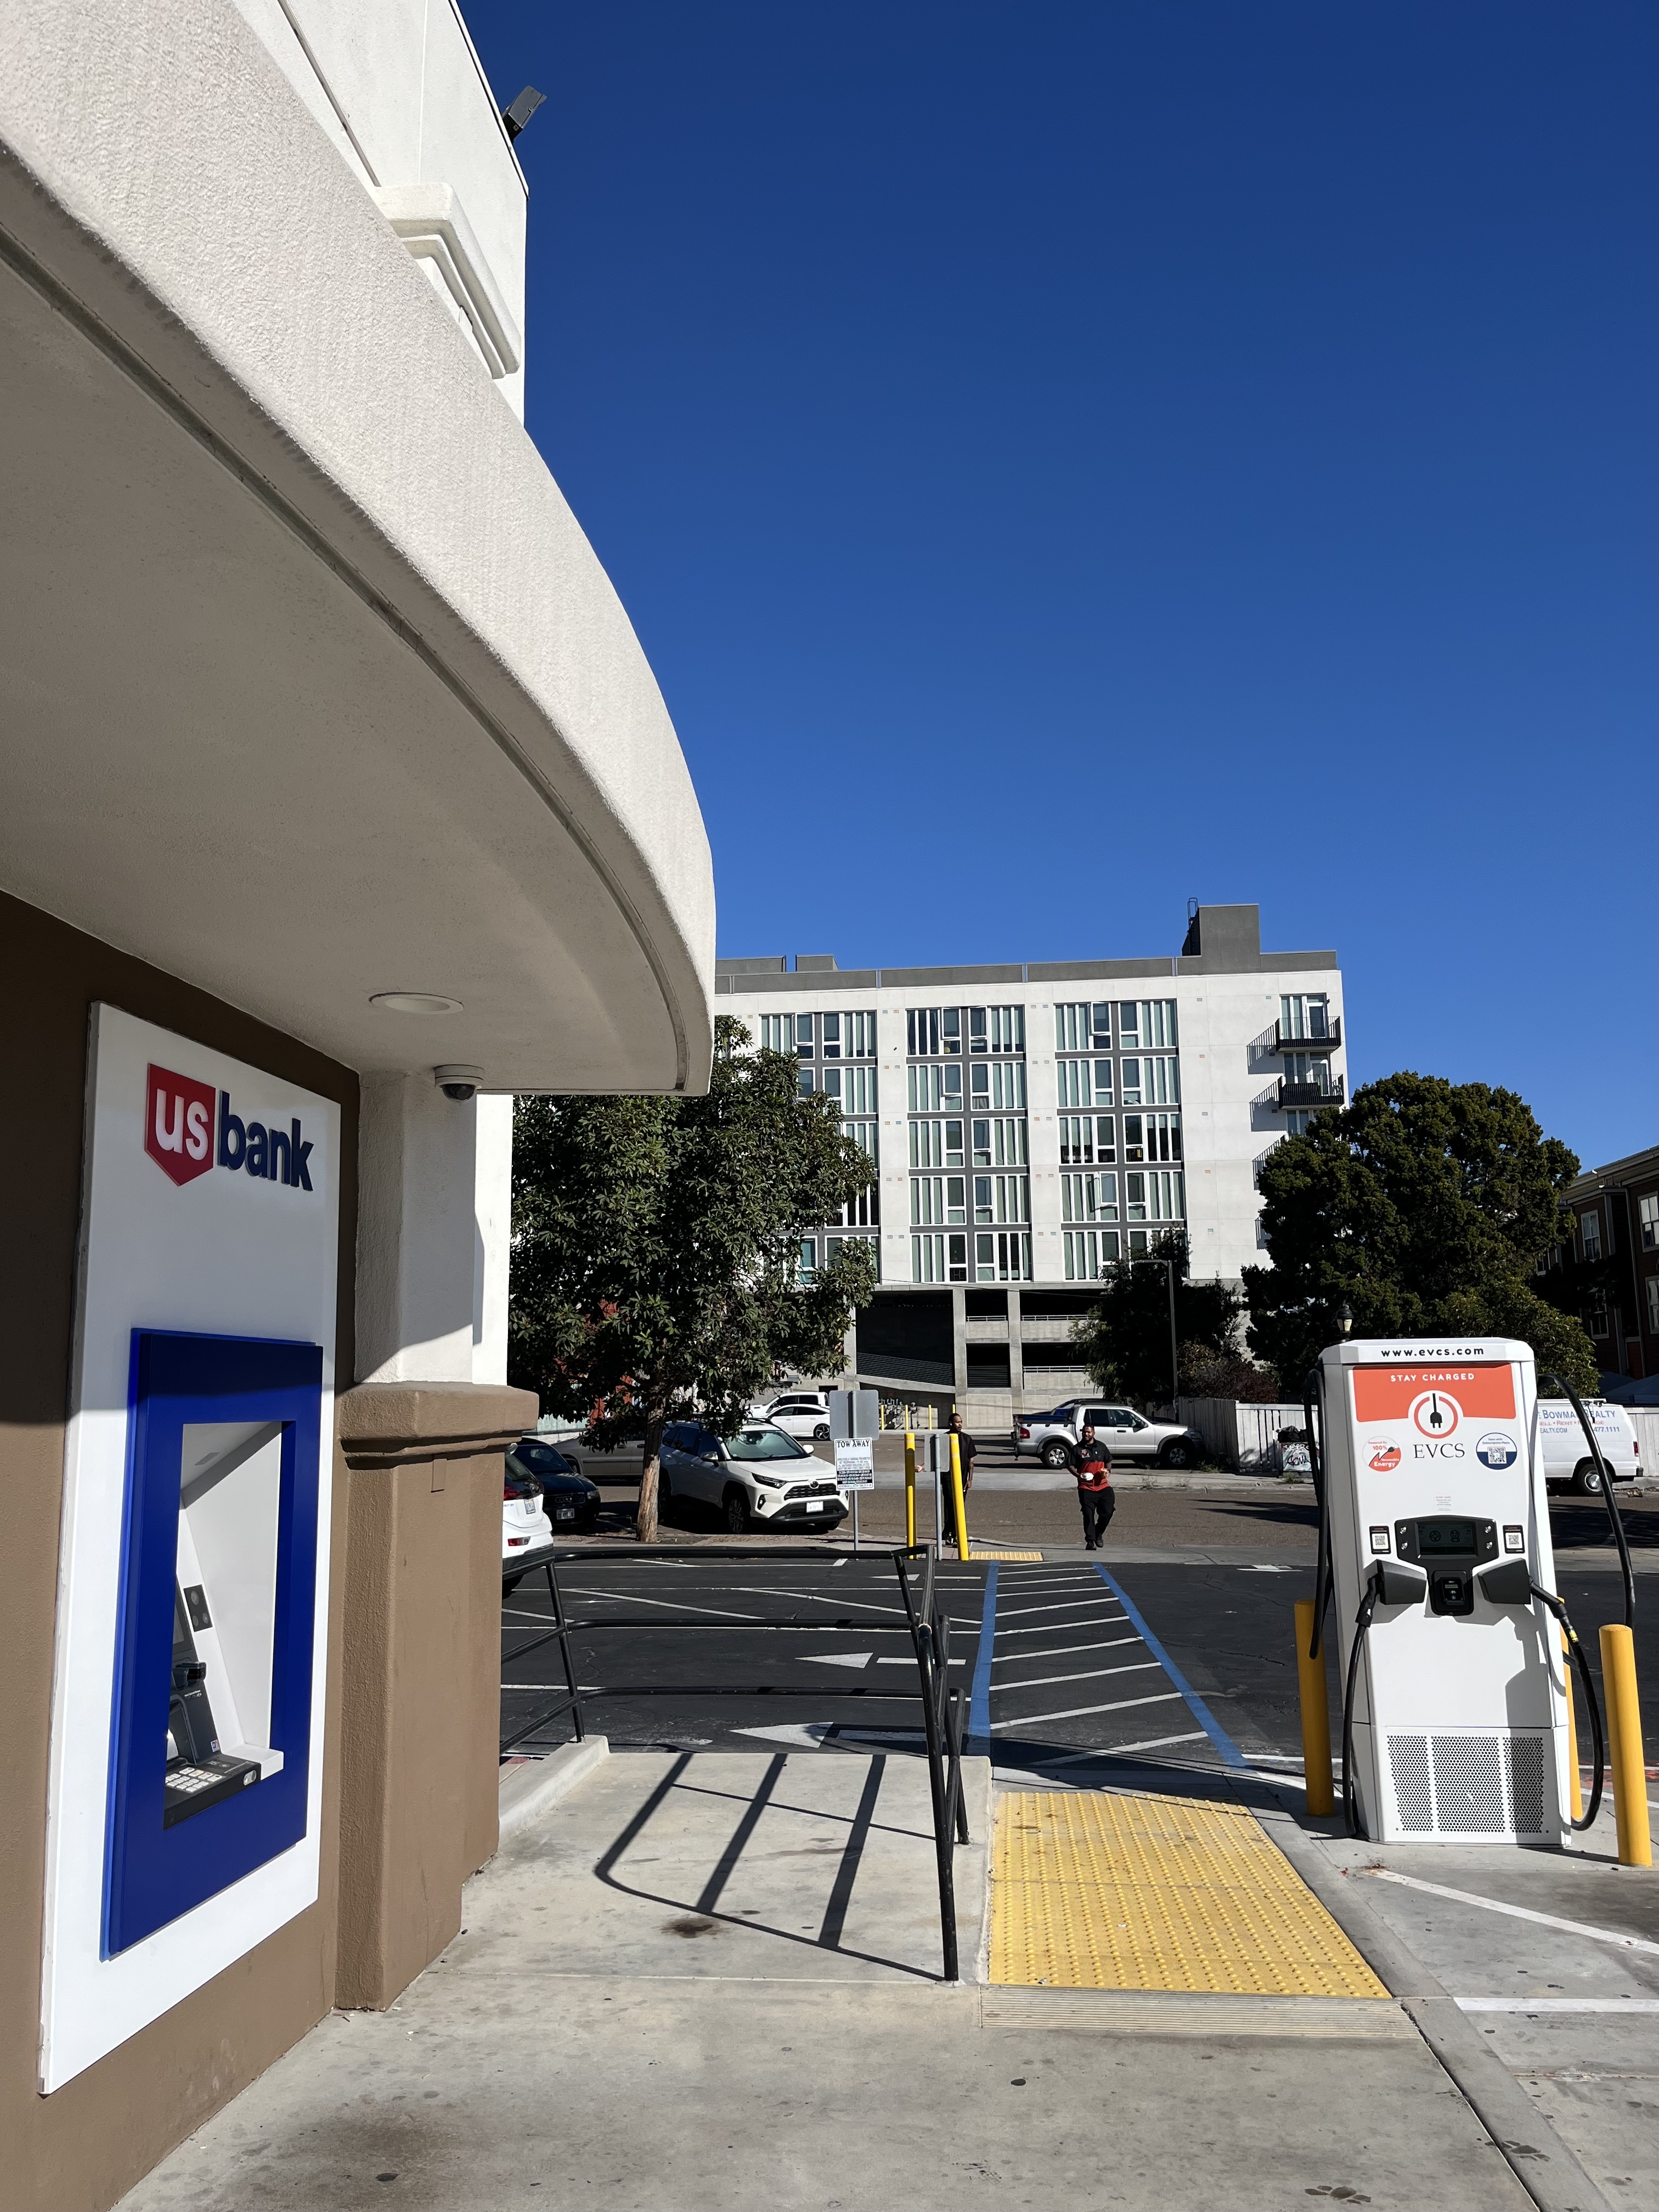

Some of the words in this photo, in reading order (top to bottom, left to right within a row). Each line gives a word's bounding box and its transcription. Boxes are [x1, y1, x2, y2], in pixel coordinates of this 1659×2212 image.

[217, 1090, 314, 1192] bank
[1381, 1348, 1484, 1357] www.evcs.com
[1422, 1373, 1475, 1381] CHARGED
[1542, 1409, 1577, 1419] BOWMA
[1413, 1443, 1465, 1459] EVCS
